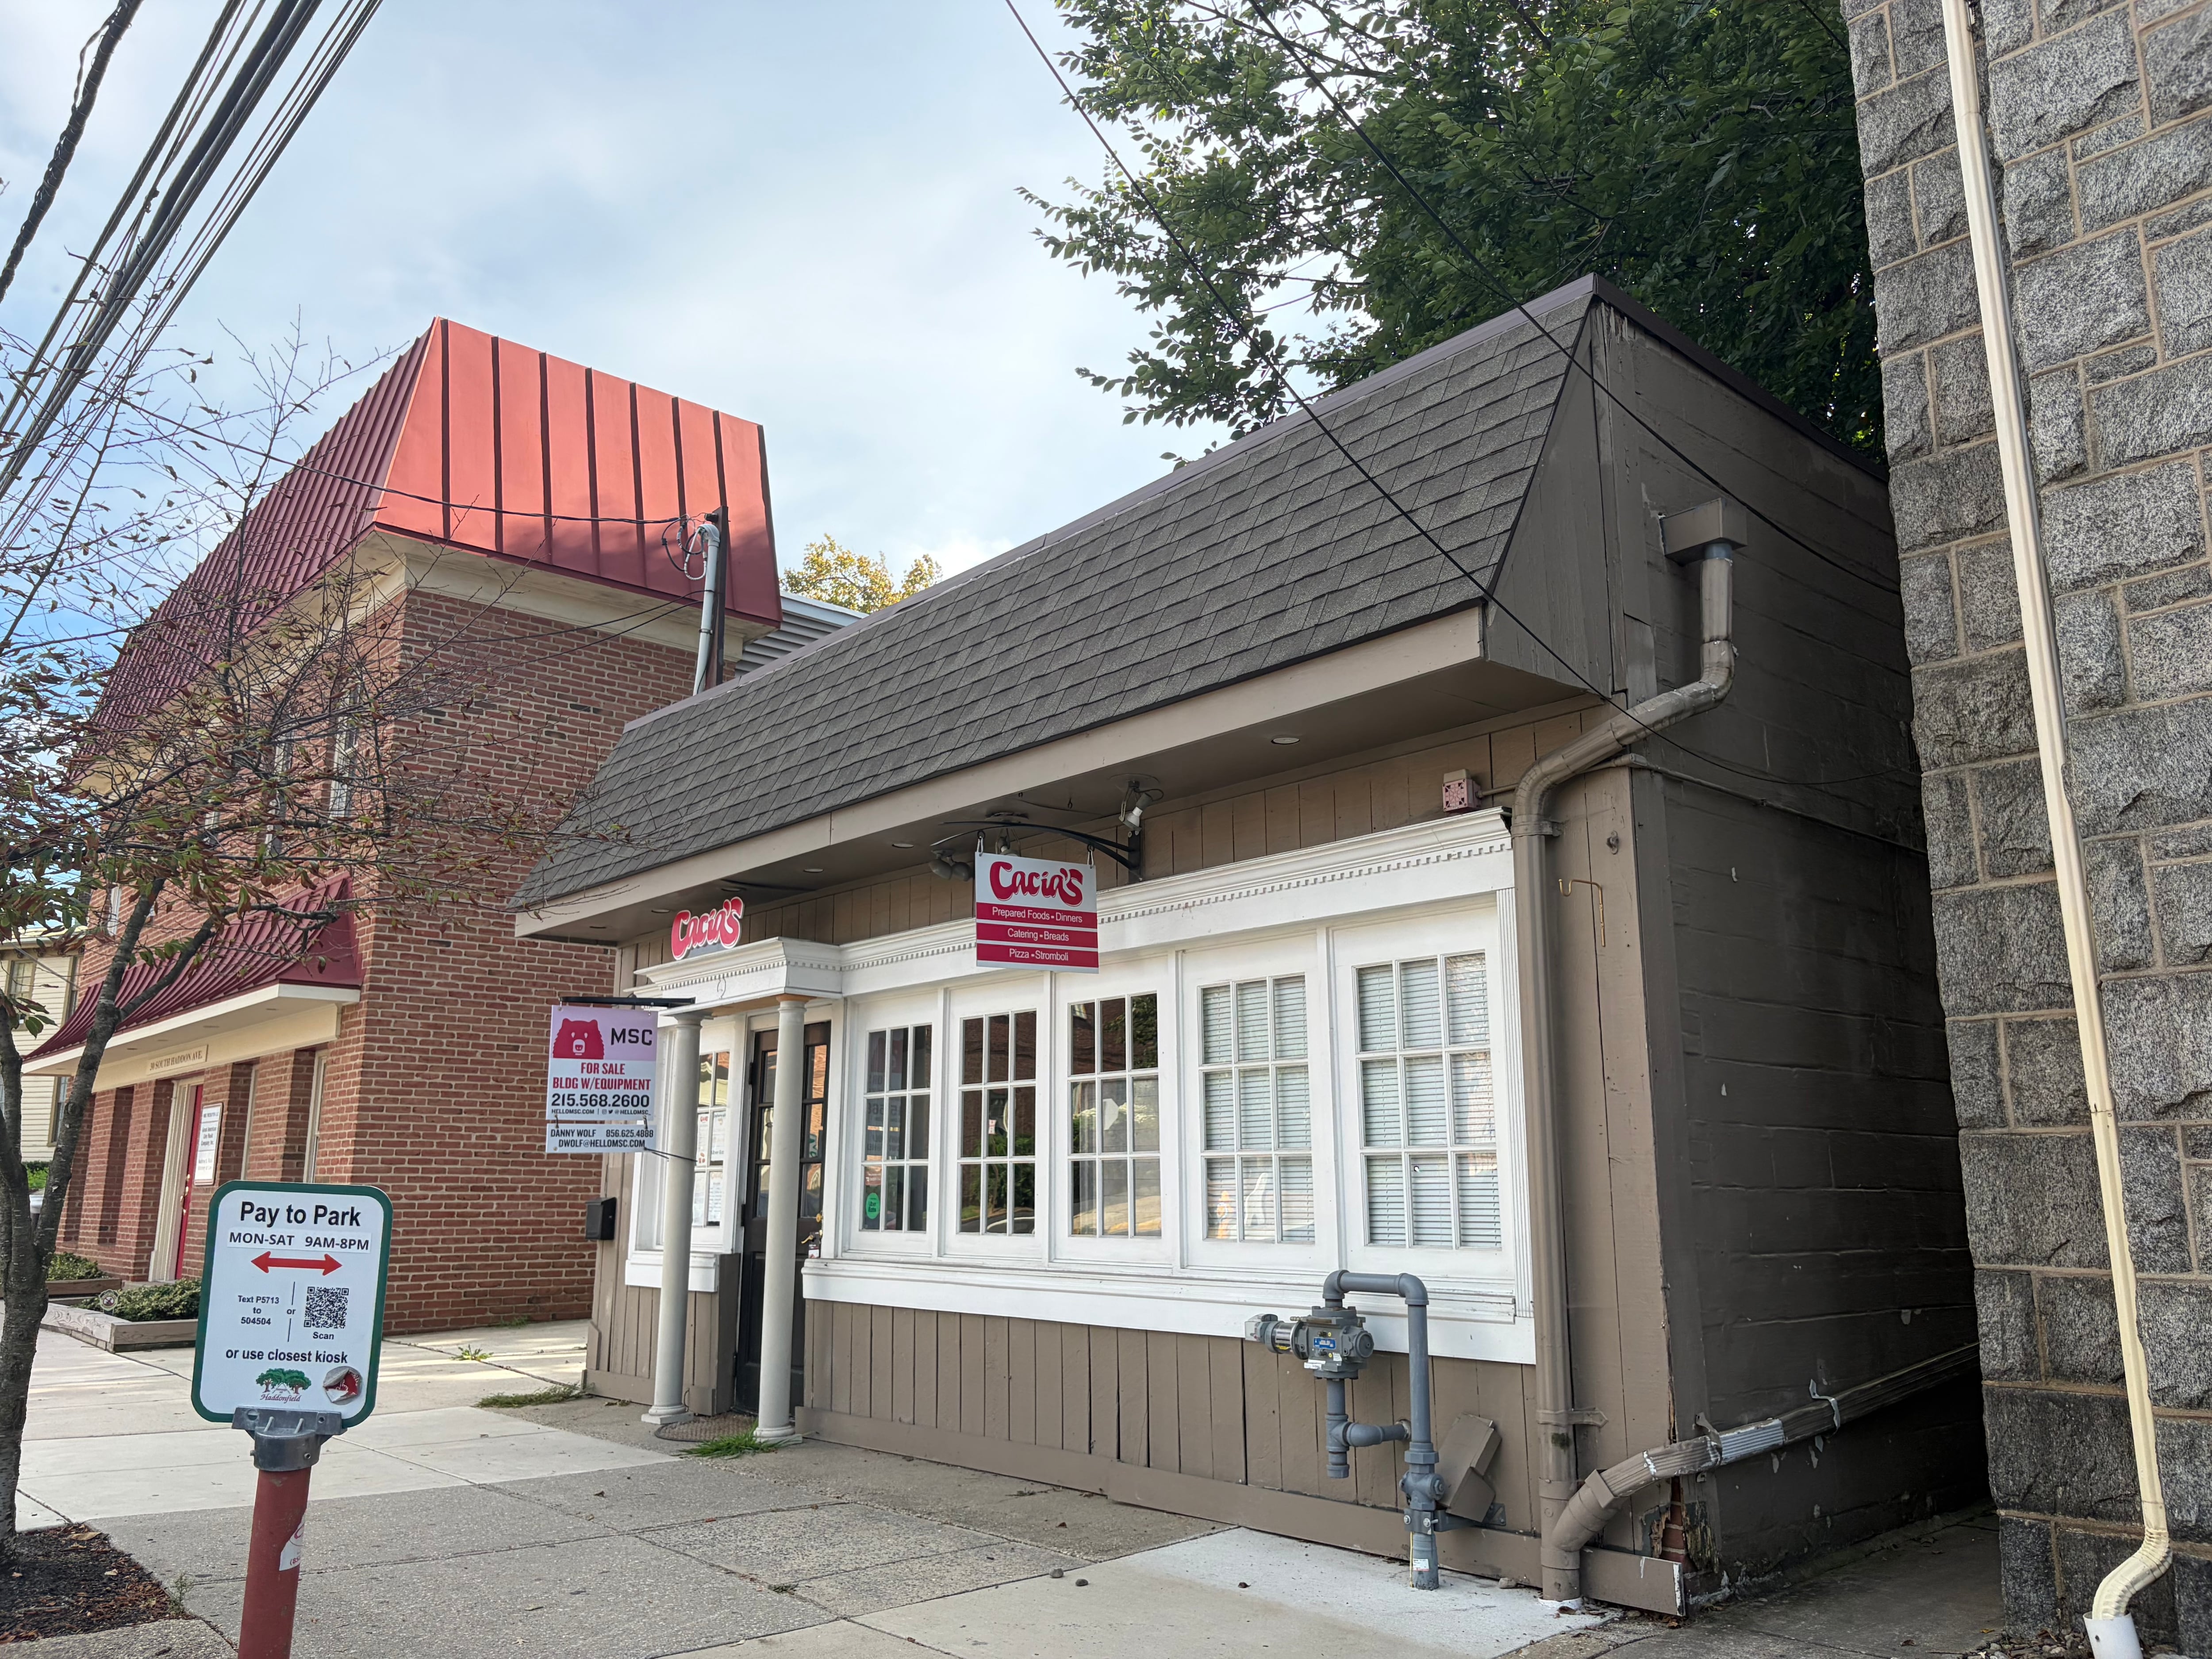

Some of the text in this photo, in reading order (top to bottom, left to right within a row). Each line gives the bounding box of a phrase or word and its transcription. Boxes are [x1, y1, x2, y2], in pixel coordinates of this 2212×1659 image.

[990, 861, 1083, 907] Cacia's
[992, 906, 1025, 918] Prepared
[1028, 910, 1050, 920] Foods
[1056, 912, 1083, 922] Dinners
[671, 896, 744, 960] Cacia's
[1008, 928, 1038, 941] Catering
[1044, 931, 1069, 941] Breads
[1010, 948, 1029, 958] Pizza
[1035, 950, 1068, 961] Stromboli
[611, 1028, 653, 1046] MSC
[581, 1062, 625, 1075] FOR SALE
[553, 1077, 651, 1090] BLDG W/EQUIPMENT
[551, 1093, 650, 1107] 215.568.2600
[240, 1201, 361, 1228] Pay to Park
[229, 1232, 369, 1250] MON-SAT 9AM-8PM
[226, 1349, 348, 1363] or use closest kiosk
[260, 1394, 302, 1403] Haddonfield
